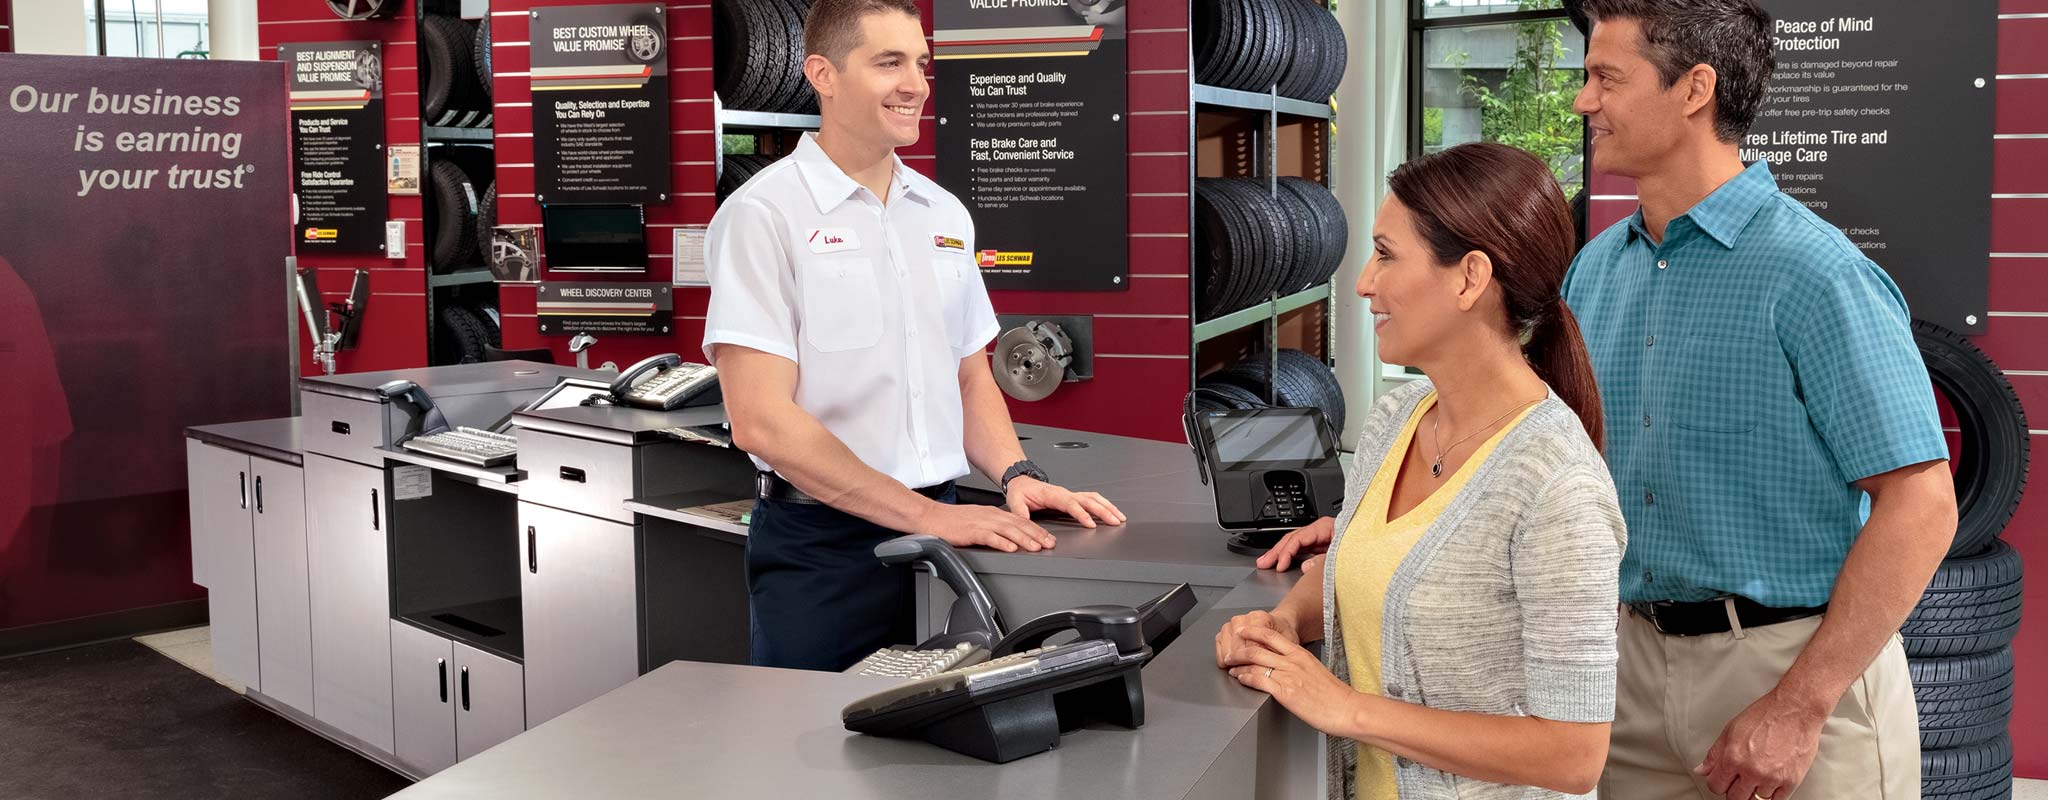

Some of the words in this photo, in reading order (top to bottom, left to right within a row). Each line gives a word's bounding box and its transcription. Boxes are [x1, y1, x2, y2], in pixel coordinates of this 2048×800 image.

[1775, 19, 1817, 34] Peace
[1821, 19, 1835, 32] of
[1838, 17, 1873, 32] Mind
[553, 27, 577, 39] BEST
[579, 26, 618, 38] CUSTOM
[619, 25, 651, 37] WHEEL
[553, 40, 582, 53] VALUE
[584, 39, 624, 51] PROMISE
[1773, 36, 1839, 51] Protection
[297, 52, 315, 61] BEST
[315, 50, 355, 60] ALIGNMENT
[297, 62, 312, 71] AND
[313, 61, 357, 71] SUSPENSION
[1801, 61, 1839, 70] damaged
[1842, 60, 1872, 69] beyond
[1875, 59, 1898, 68] repair
[297, 73, 319, 82] VALUE
[320, 72, 351, 82] PROMISE
[970, 74, 1016, 86] Experience
[1018, 73, 1035, 83] and
[1037, 72, 1066, 84] Quality
[970, 86, 985, 97] You
[988, 86, 1004, 96] Can
[1006, 85, 1026, 95] Trust
[1832, 84, 1879, 93] guaranteed
[10, 85, 78, 113] Our
[87, 87, 240, 116] business
[555, 101, 578, 110] Quality,
[579, 101, 607, 109] Selection
[608, 100, 620, 108] and
[621, 100, 649, 109] Expertise
[582, 110, 595, 119] Rely
[1802, 108, 1832, 117] pre-trip
[1834, 108, 1858, 116] safety
[75, 125, 104, 152] is
[116, 127, 242, 159] earning
[971, 138, 990, 148] Free
[992, 138, 1016, 148] Brake
[1018, 138, 1038, 148] Care
[1040, 137, 1056, 147] and
[1746, 134, 1768, 145] ree
[1773, 131, 1827, 145] Lifetime
[1831, 130, 1856, 144] Tire
[1861, 130, 1887, 144] and
[971, 150, 991, 162] Fast,
[993, 149, 1040, 160] Convenient
[1042, 148, 1074, 159] Service
[1739, 149, 1791, 164] Mileage
[1796, 148, 1827, 162] Care
[78, 169, 158, 196] your
[1796, 173, 1823, 182] repairs
[1782, 186, 1816, 194] rotations
[824, 235, 843, 244] Luke
[586, 289, 623, 297] DISCOVERY
[625, 289, 652, 297] CENTER
